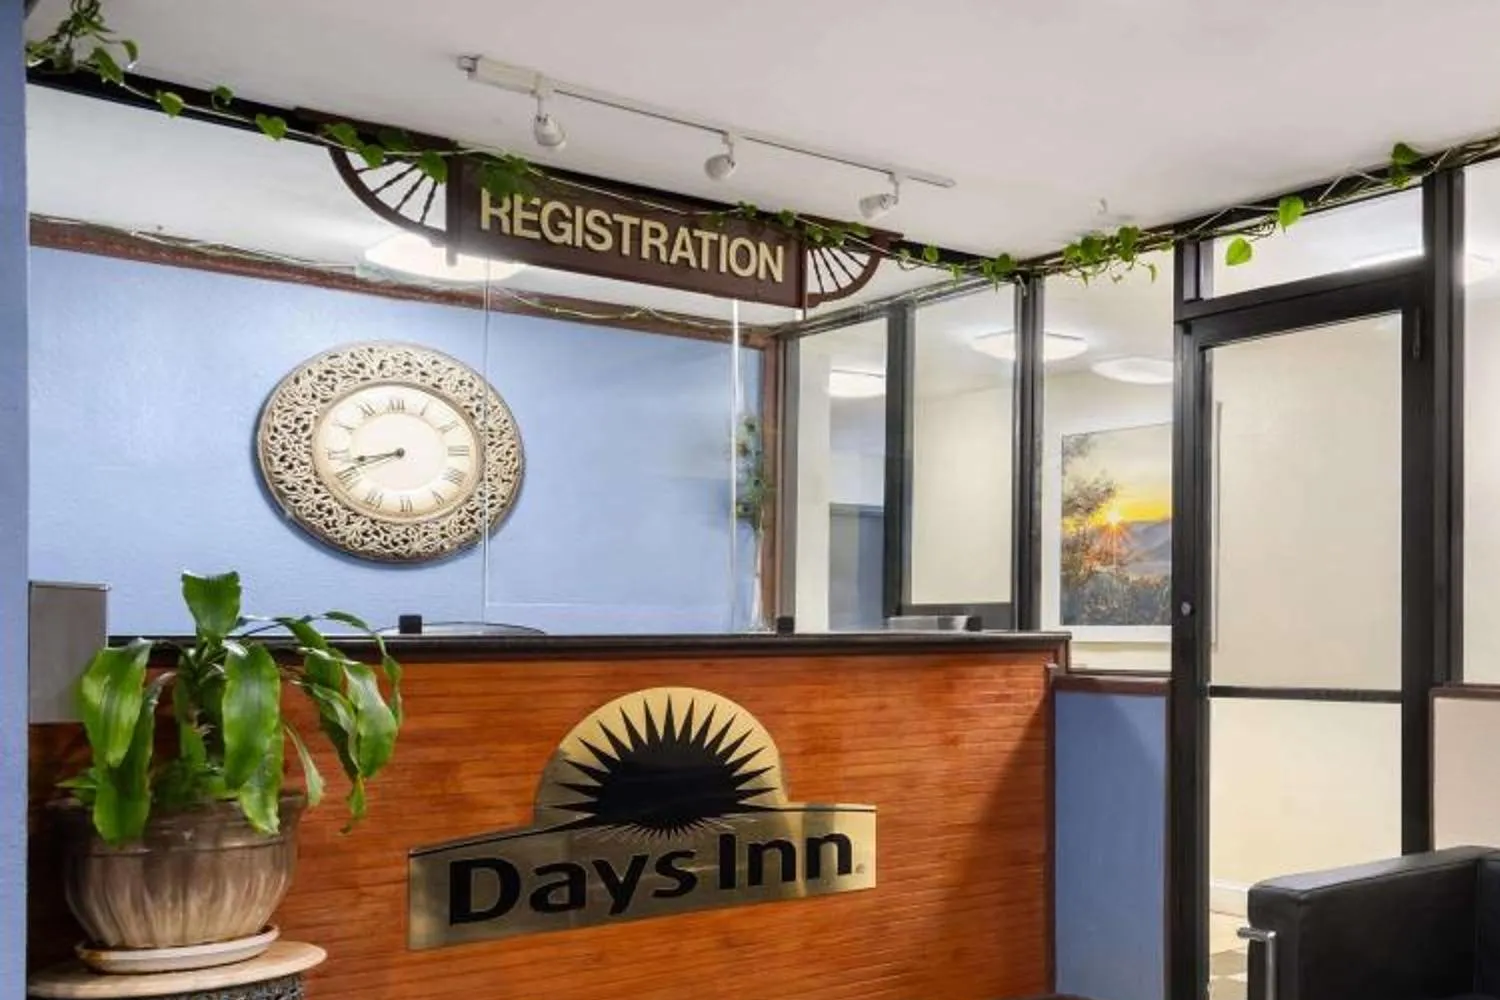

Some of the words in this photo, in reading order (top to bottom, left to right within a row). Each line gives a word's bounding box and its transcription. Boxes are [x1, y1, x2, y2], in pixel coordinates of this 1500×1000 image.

[481, 187, 784, 282] REGISTRATION
[448, 849, 698, 926] Days
[718, 831, 852, 890] Inn
